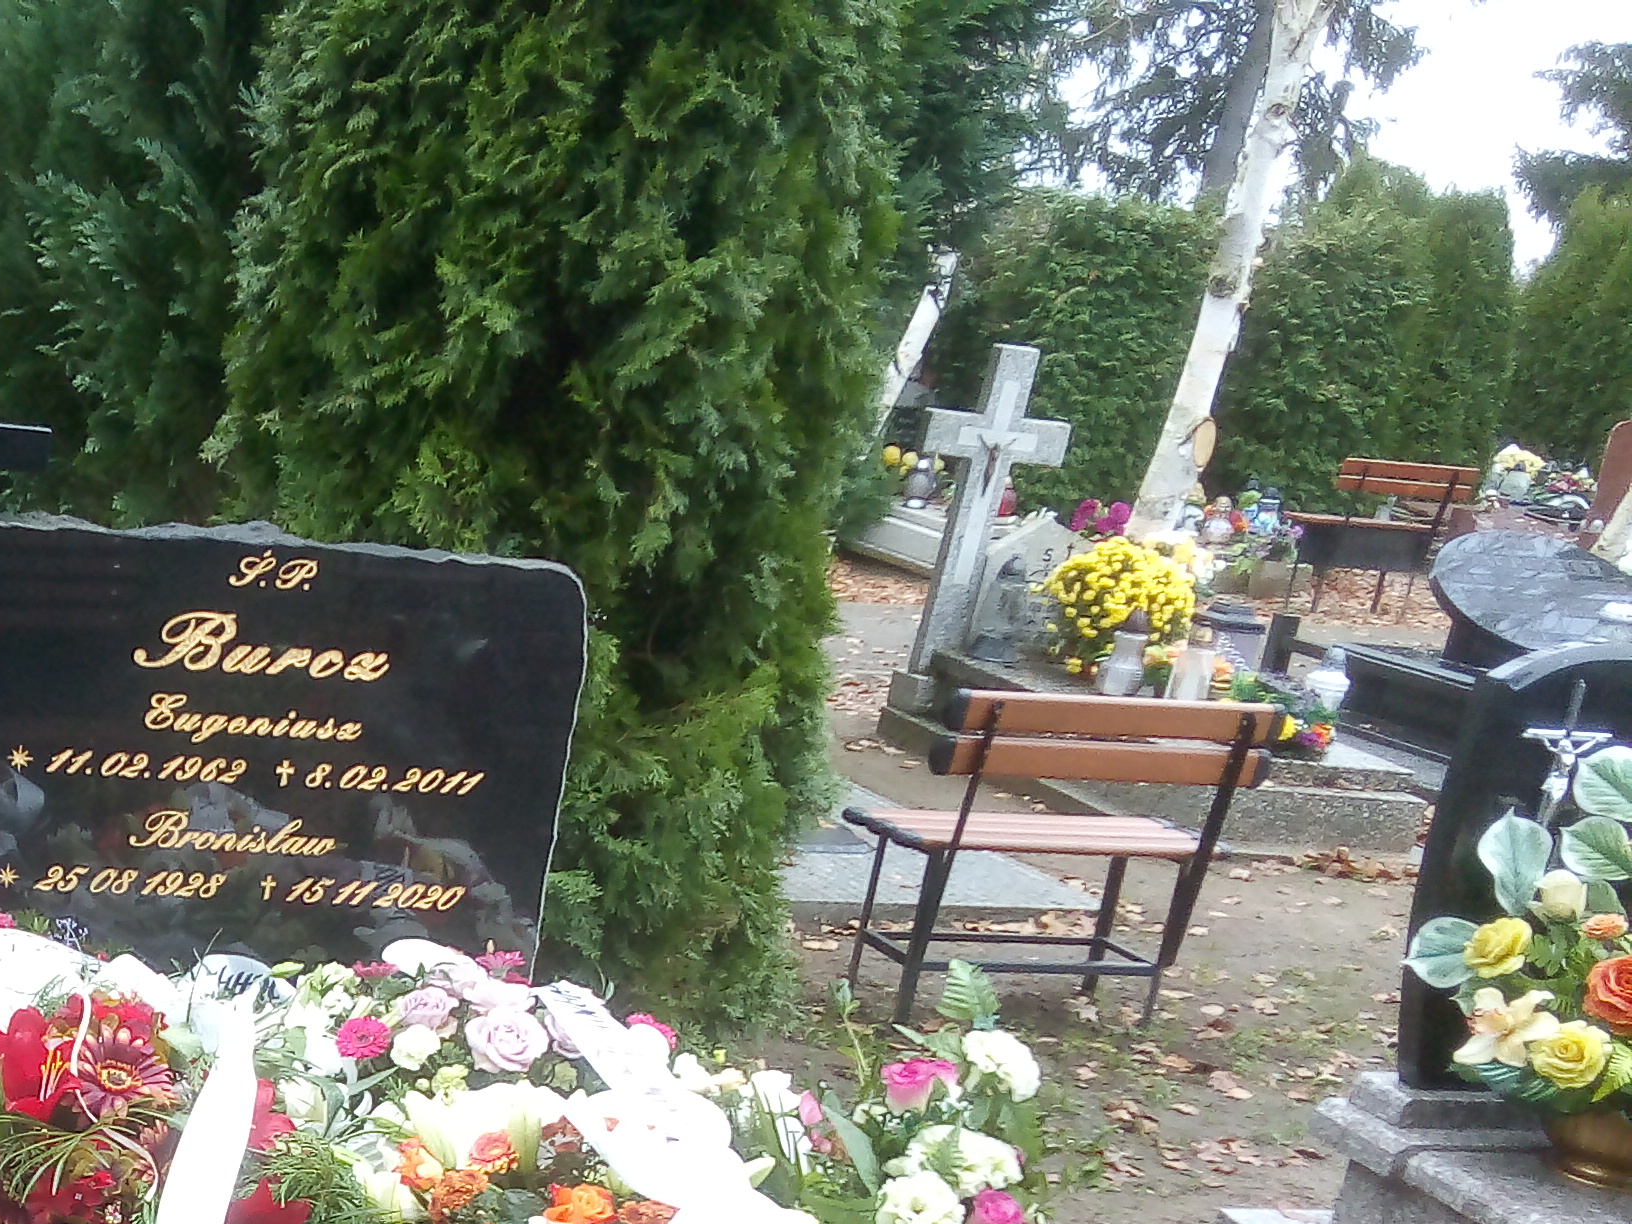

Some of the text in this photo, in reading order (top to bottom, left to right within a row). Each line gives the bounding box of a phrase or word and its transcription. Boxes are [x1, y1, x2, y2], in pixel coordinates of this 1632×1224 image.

[133, 611, 390, 682] Burcz
[144, 693, 363, 743] Eugeniusz
[44, 748, 486, 796] 11.02.1962 8.02.2011
